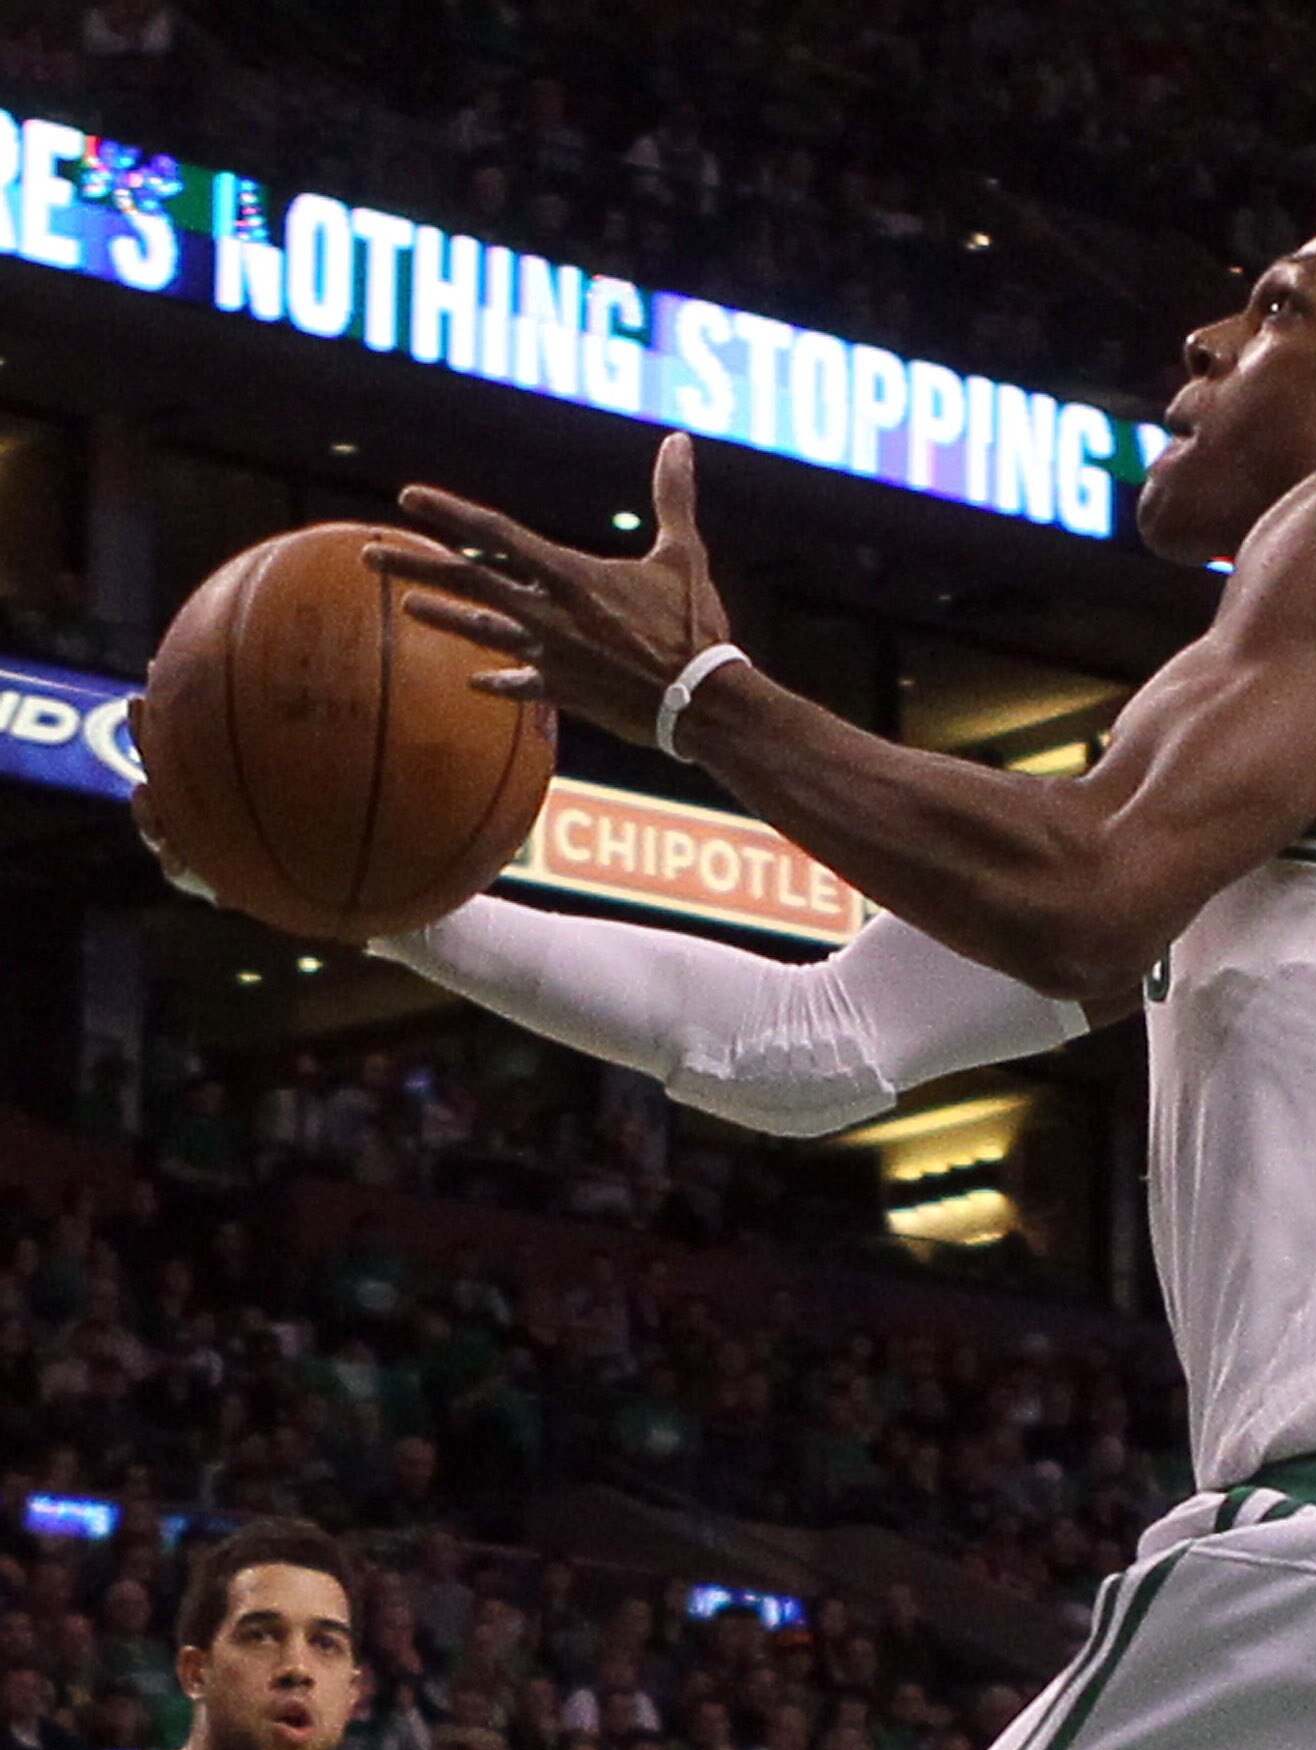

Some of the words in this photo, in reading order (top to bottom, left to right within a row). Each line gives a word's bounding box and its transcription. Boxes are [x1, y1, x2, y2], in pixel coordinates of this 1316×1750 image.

[0, 108, 179, 292] ES
[213, 170, 643, 413] NOTHING
[675, 298, 1114, 540] STOPPING
[553, 808, 843, 915] CHIPOTLE
